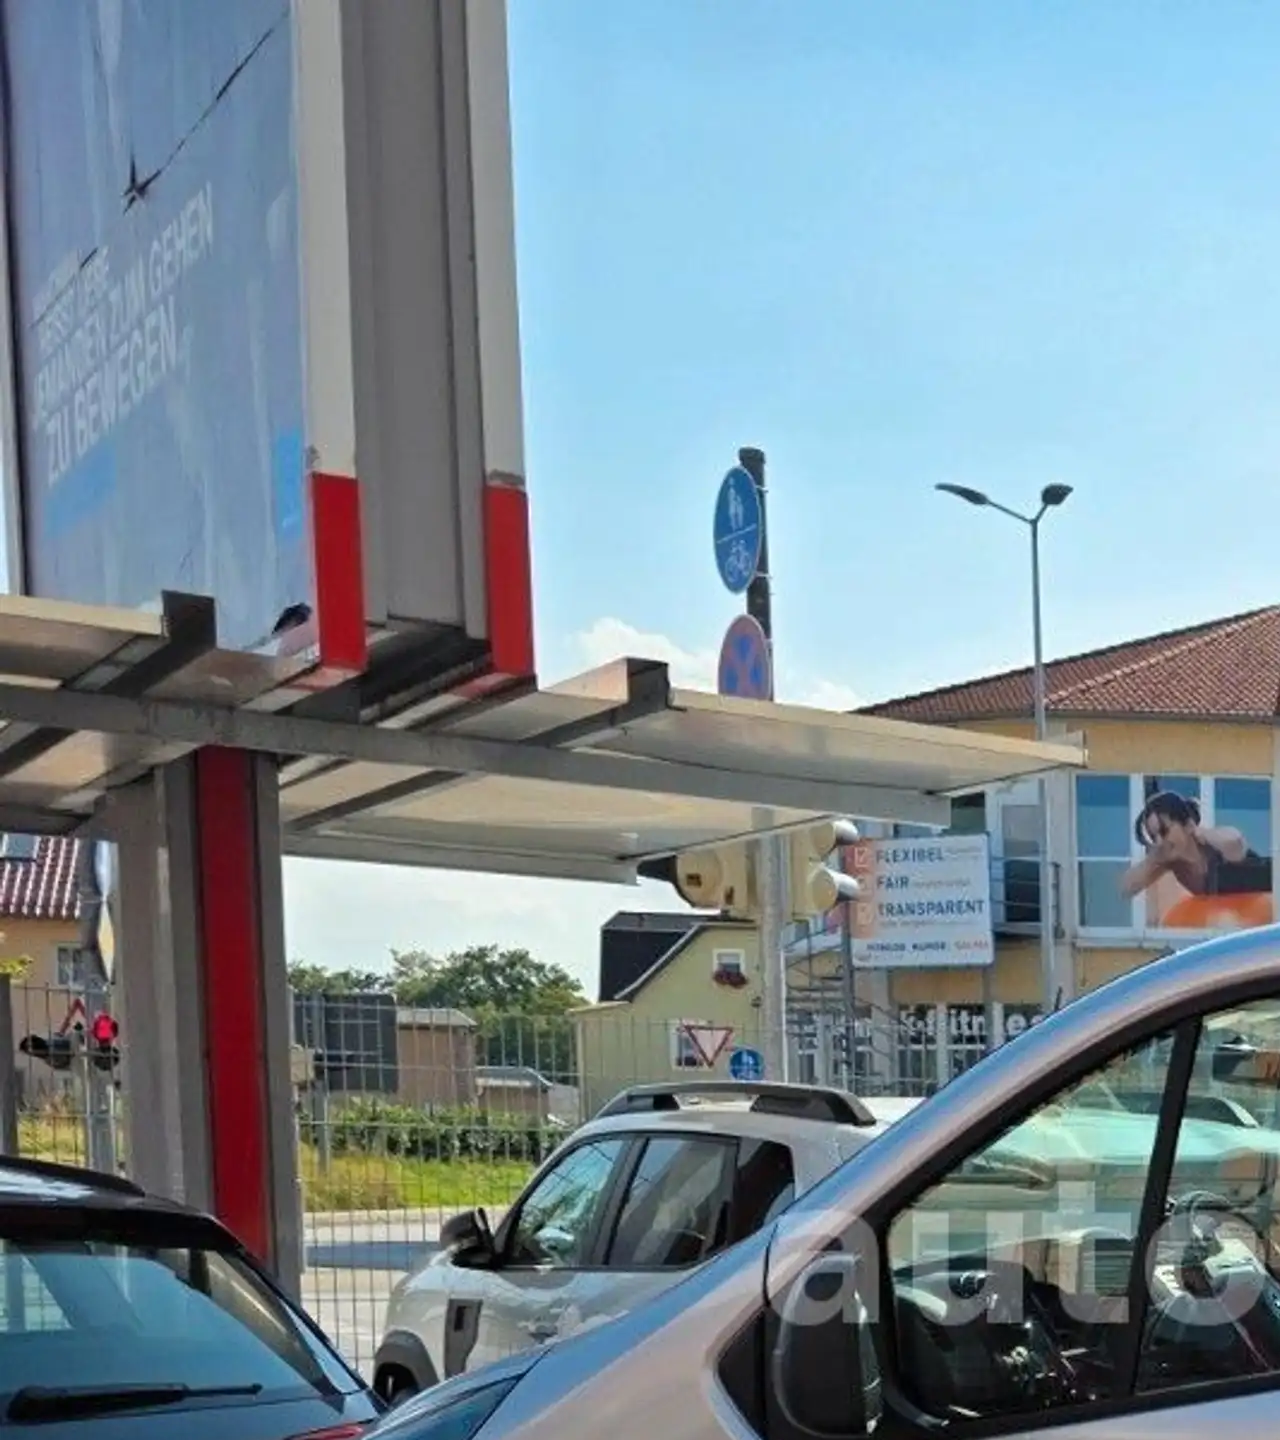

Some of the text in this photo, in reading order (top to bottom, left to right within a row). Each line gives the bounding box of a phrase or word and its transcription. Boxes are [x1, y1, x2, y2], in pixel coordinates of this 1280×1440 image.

[150, 179, 213, 298] GEHEN
[48, 405, 70, 487] ZU
[876, 847, 943, 864] FLEXIBEL
[877, 875, 909, 890] FAIR
[878, 900, 985, 916] TRANSPARENT
